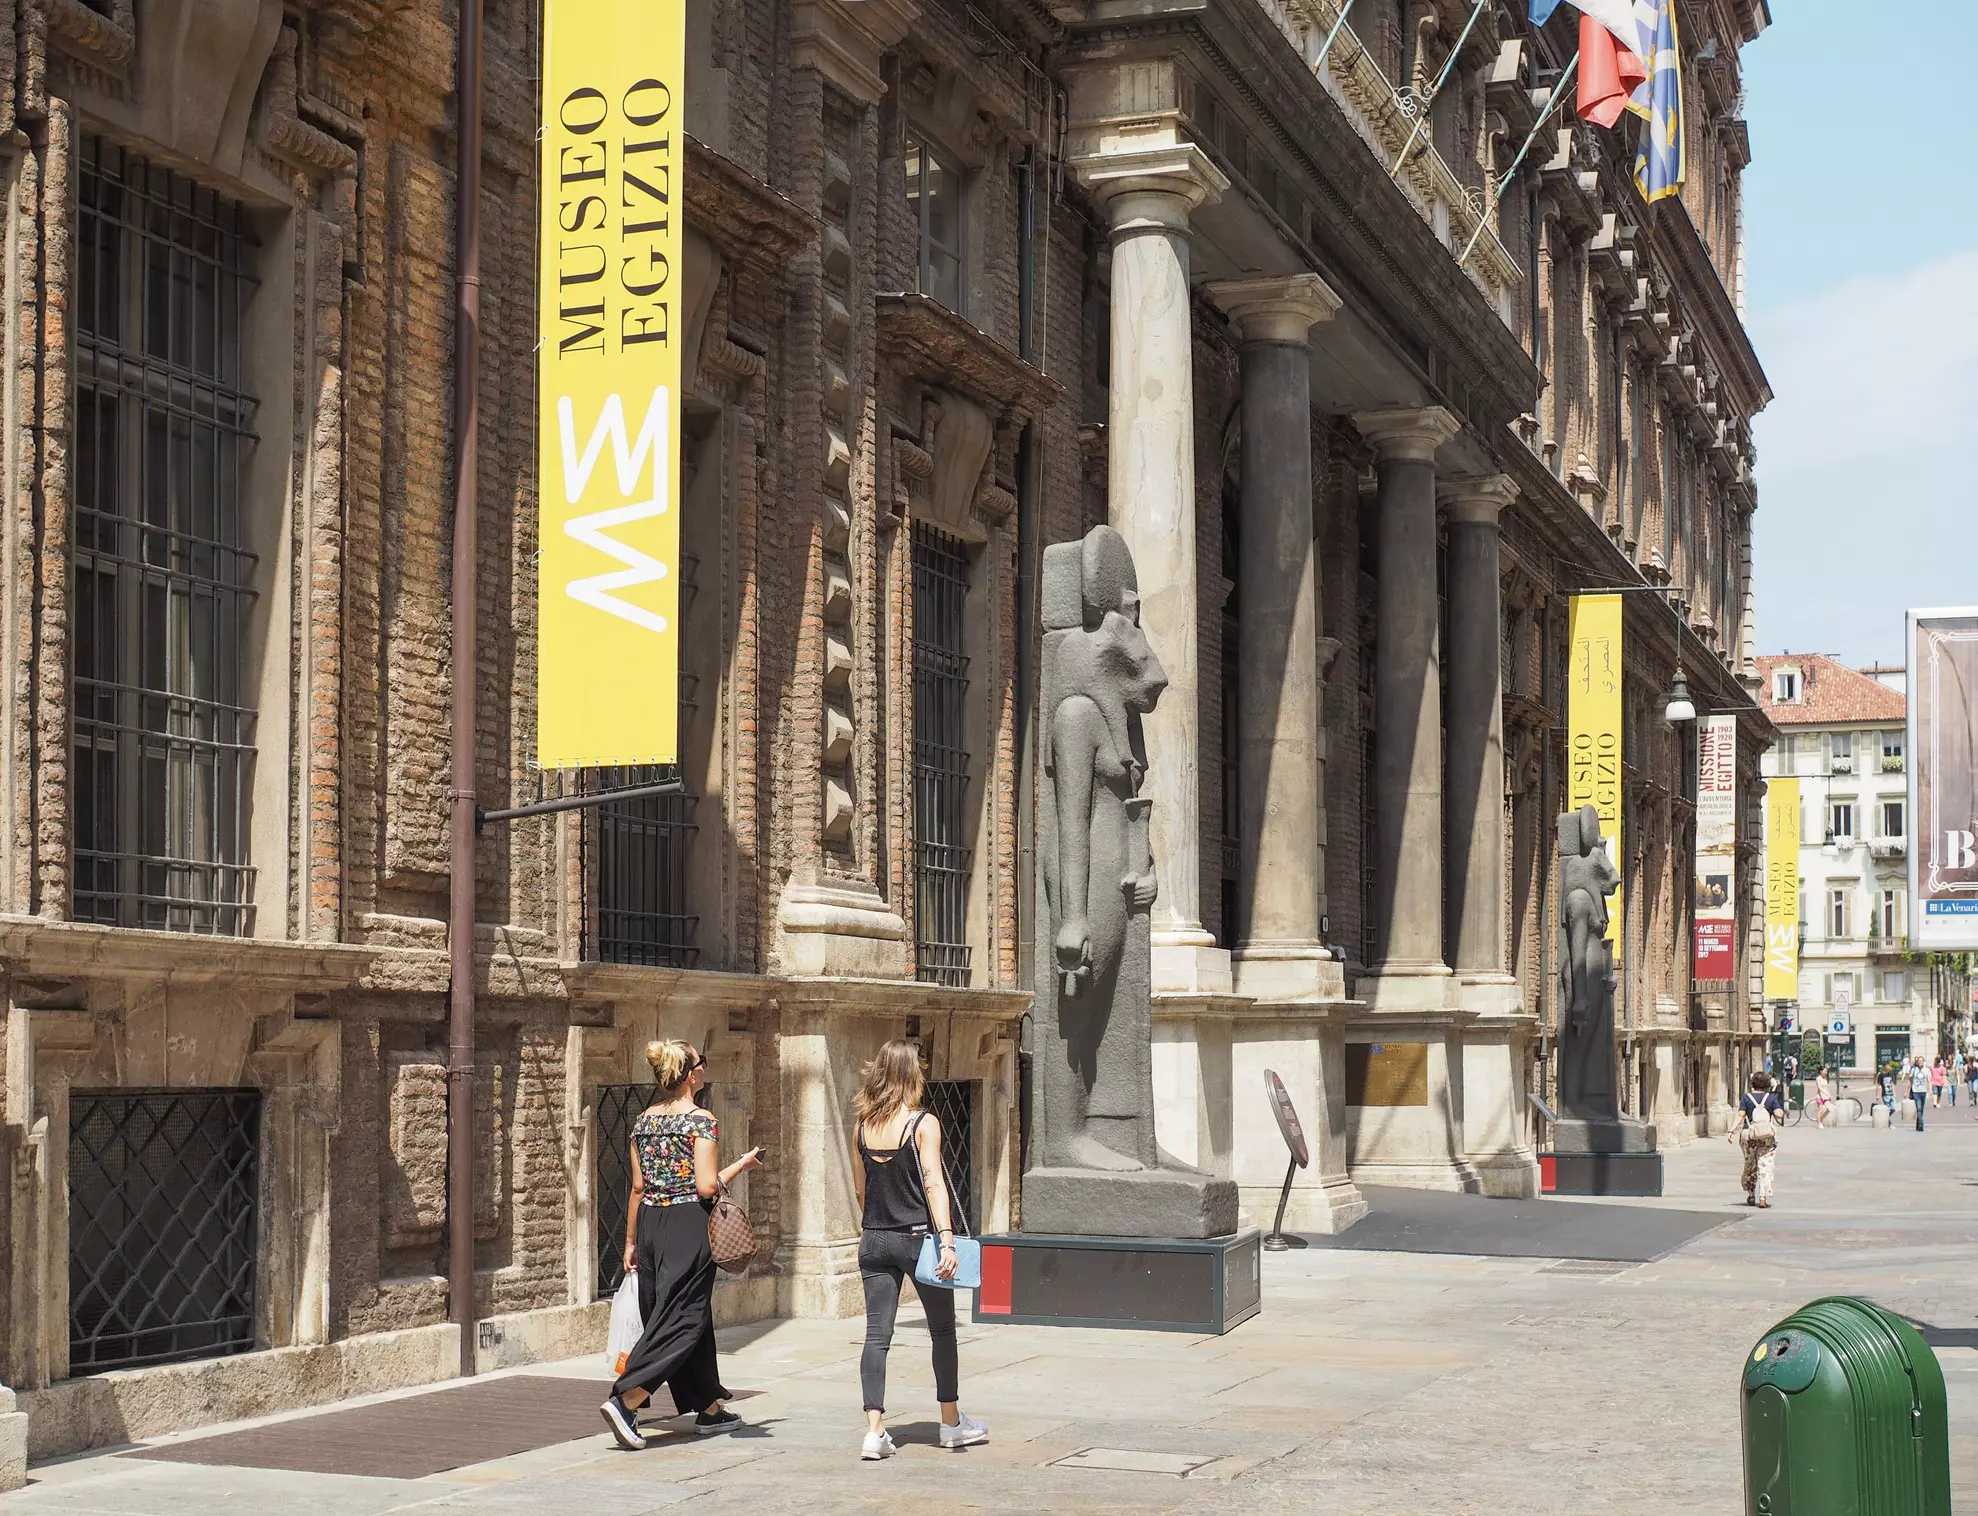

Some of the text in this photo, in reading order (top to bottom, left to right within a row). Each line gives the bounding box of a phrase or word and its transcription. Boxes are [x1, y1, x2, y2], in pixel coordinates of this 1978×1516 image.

[559, 87, 608, 360] MUSEO
[620, 78, 671, 354] EGIZIO
[1597, 637, 1617, 693] المصري
[1574, 733, 1593, 811] USEO
[1597, 733, 1616, 823] EGIZIO
[1699, 726, 1715, 792] MISSIONE
[1717, 742, 1733, 792] EGITTO
[1769, 862, 1781, 916] MUSEO
[1783, 862, 1796, 916] EGIZIO
[1940, 903, 1952, 912] La
